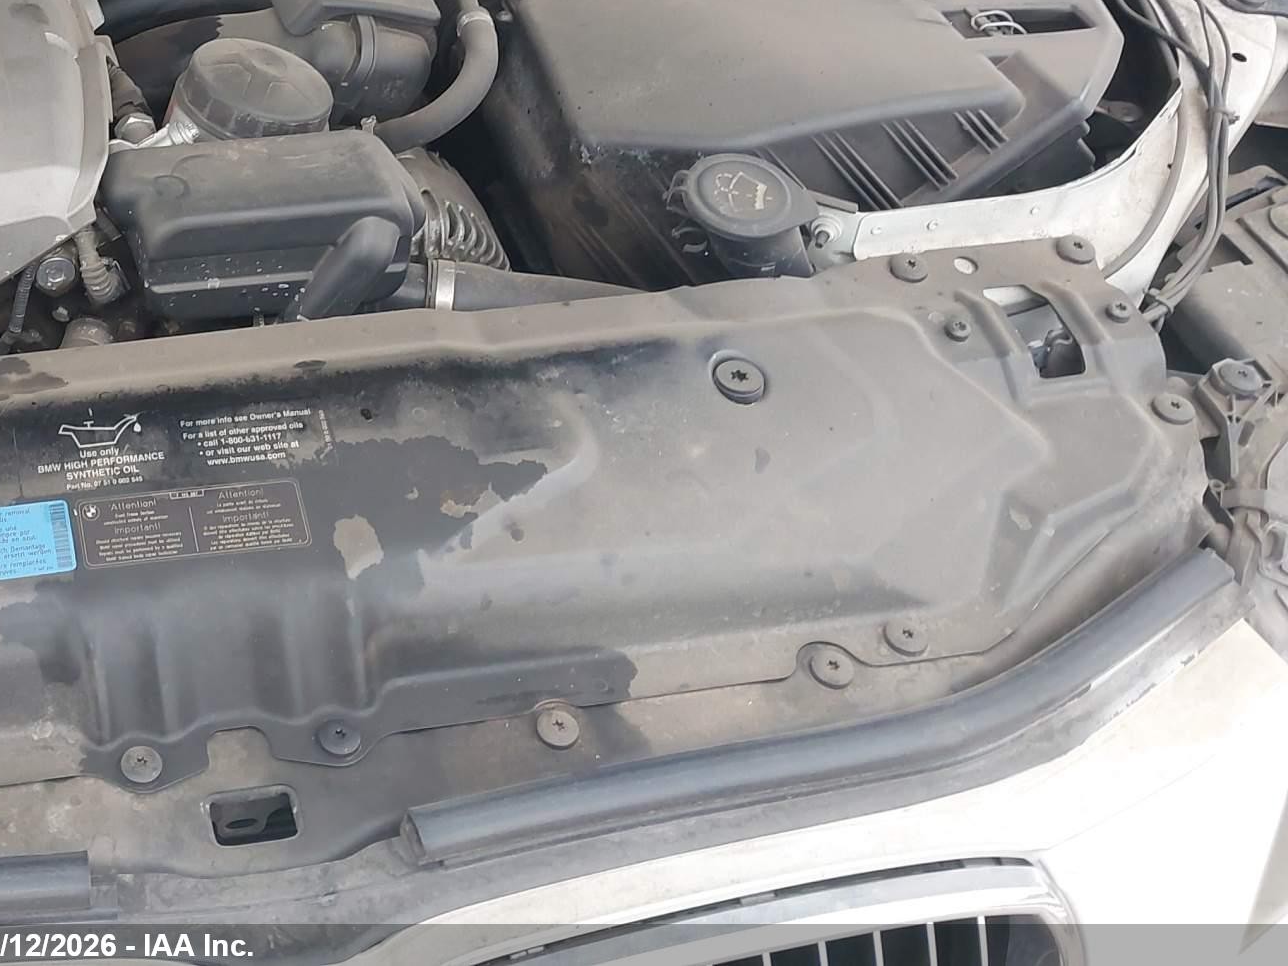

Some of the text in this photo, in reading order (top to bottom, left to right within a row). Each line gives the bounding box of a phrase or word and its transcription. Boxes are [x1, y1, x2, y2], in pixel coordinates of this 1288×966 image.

[180, 407, 311, 428] For more info see Owner's Manual
[182, 432, 196, 440] For
[204, 429, 218, 438] list
[219, 428, 227, 437] of
[228, 425, 249, 436] other
[251, 421, 288, 434] approved
[289, 421, 304, 430] oils
[203, 439, 219, 448] call
[205, 439, 300, 457] or visit our web site at
[79, 446, 120, 459] Use only
[206, 451, 287, 466] www.bmwusa.com
[37, 451, 166, 474] BMW HIGH PERFORMANCE
[65, 464, 140, 481] SYNTHETIC OIL
[66, 482, 81, 491] Part
[218, 487, 264, 500] Attention!
[111, 498, 157, 511] Attention!
[222, 511, 269, 524] Important!
[114, 521, 161, 534] Important!
